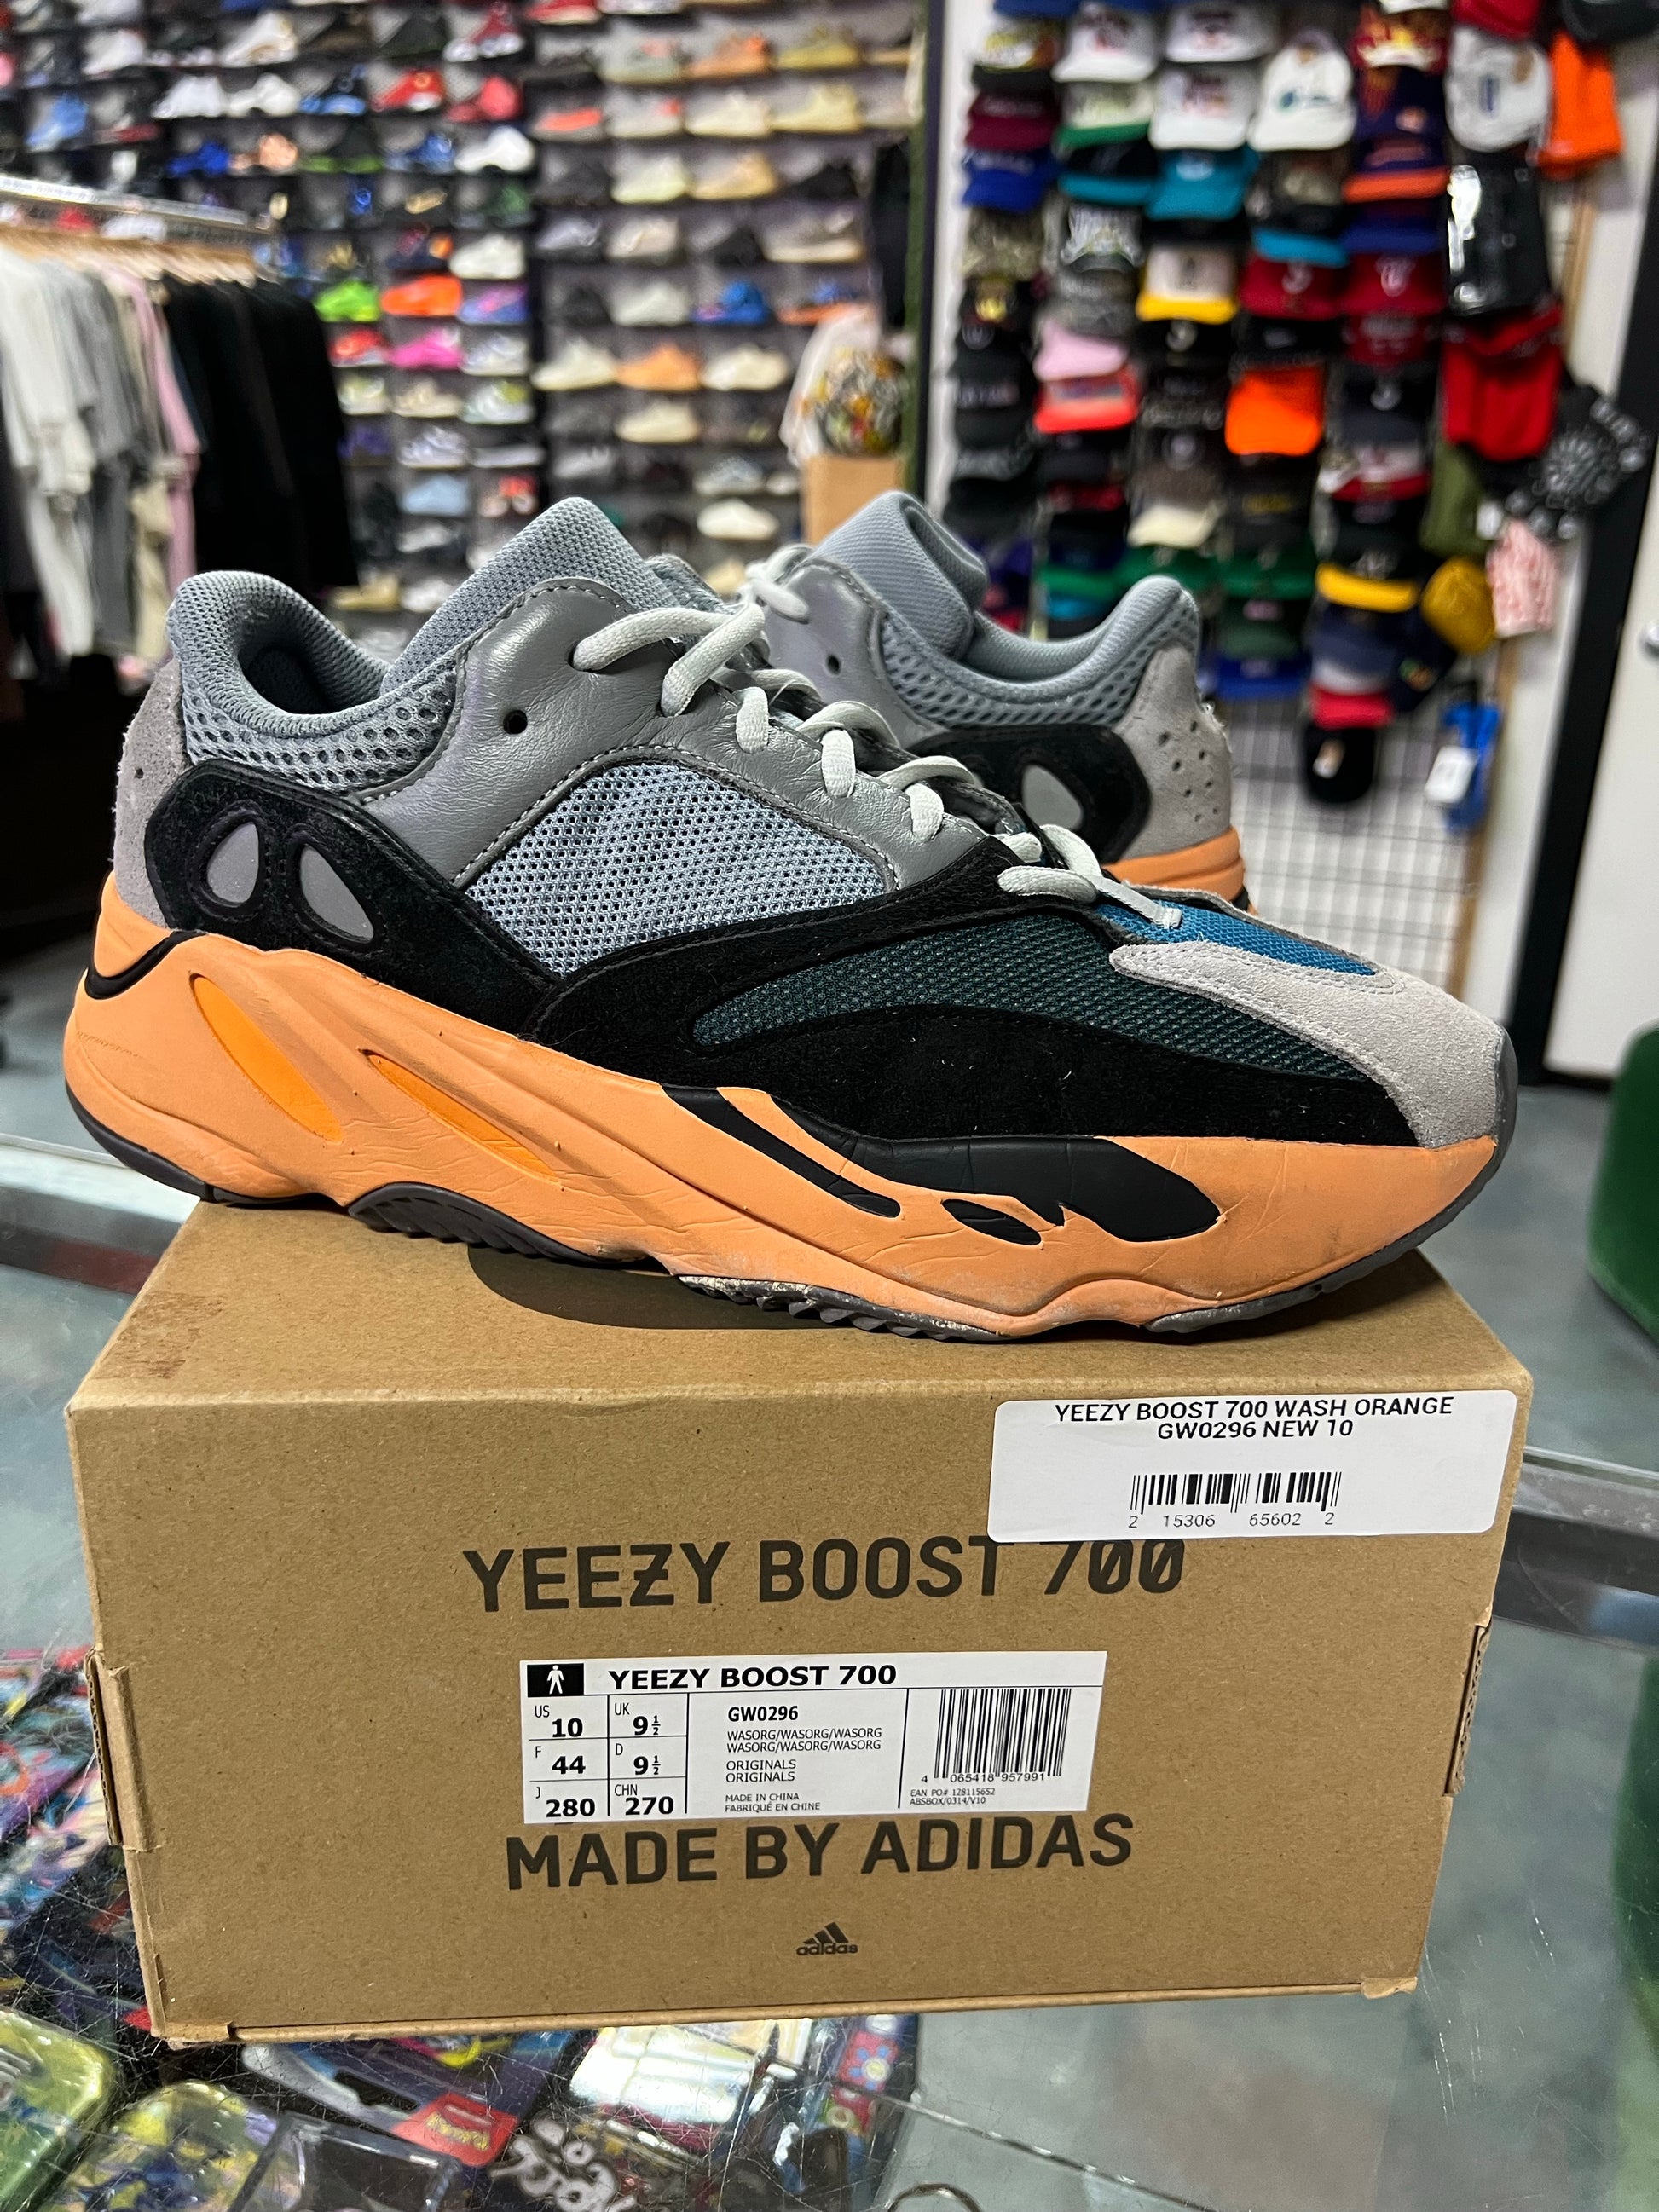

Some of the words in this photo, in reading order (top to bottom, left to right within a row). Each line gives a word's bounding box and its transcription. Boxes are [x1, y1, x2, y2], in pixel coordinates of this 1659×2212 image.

[1055, 1403, 1130, 1422] YEEZY
[1136, 1401, 1219, 1420] BOOST
[1225, 1401, 1268, 1418] 700
[1275, 1399, 1346, 1417] WASH
[1355, 1396, 1454, 1416] ORANGE
[1158, 1421, 1257, 1439] GW0296
[1263, 1420, 1319, 1437] NEW
[1327, 1419, 1354, 1436] 10
[1128, 1515, 1138, 1528] 2
[1163, 1514, 1216, 1528] 15306
[1249, 1512, 1302, 1526] 65602
[1324, 1512, 1334, 1525] 2
[462, 1541, 731, 1612] YEEZY
[759, 1535, 1014, 1603] BOOST
[1038, 1539, 1185, 1596] 700
[608, 1668, 710, 1690] YEEZY
[721, 1666, 829, 1688] BOOST
[839, 1665, 897, 1685] 700
[535, 1705, 550, 1718] US
[614, 1702, 630, 1715] UK
[727, 1705, 799, 1722] GW0296
[552, 1718, 583, 1737] 10
[727, 1727, 882, 1741] WASORG/WASORG/WASORG
[535, 1746, 541, 1758] F
[615, 1743, 623, 1755] D
[726, 1740, 882, 1753] WASORG/WASORG/WASORG
[552, 1755, 586, 1775] 44
[726, 1759, 796, 1770] ORIGINALS
[725, 1771, 795, 1782] ORIGINALS
[921, 1775, 928, 1783] 4
[950, 1774, 994, 1782] 065418
[1001, 1772, 1045, 1782] 957991
[535, 1787, 540, 1799] J
[614, 1784, 638, 1796] CHN
[725, 1793, 753, 1802] MADE
[769, 1793, 800, 1801] CHINA
[546, 1798, 595, 1817] 280
[625, 1796, 674, 1816] 270
[725, 1803, 772, 1813] FABRIQUÉ
[775, 1803, 788, 1811] EN
[790, 1802, 821, 1811] CHINE
[506, 1828, 718, 1890] MADE
[745, 1822, 840, 1880] BY
[860, 1813, 1134, 1874] ADIDAS
[795, 1942, 859, 1956] adidas
